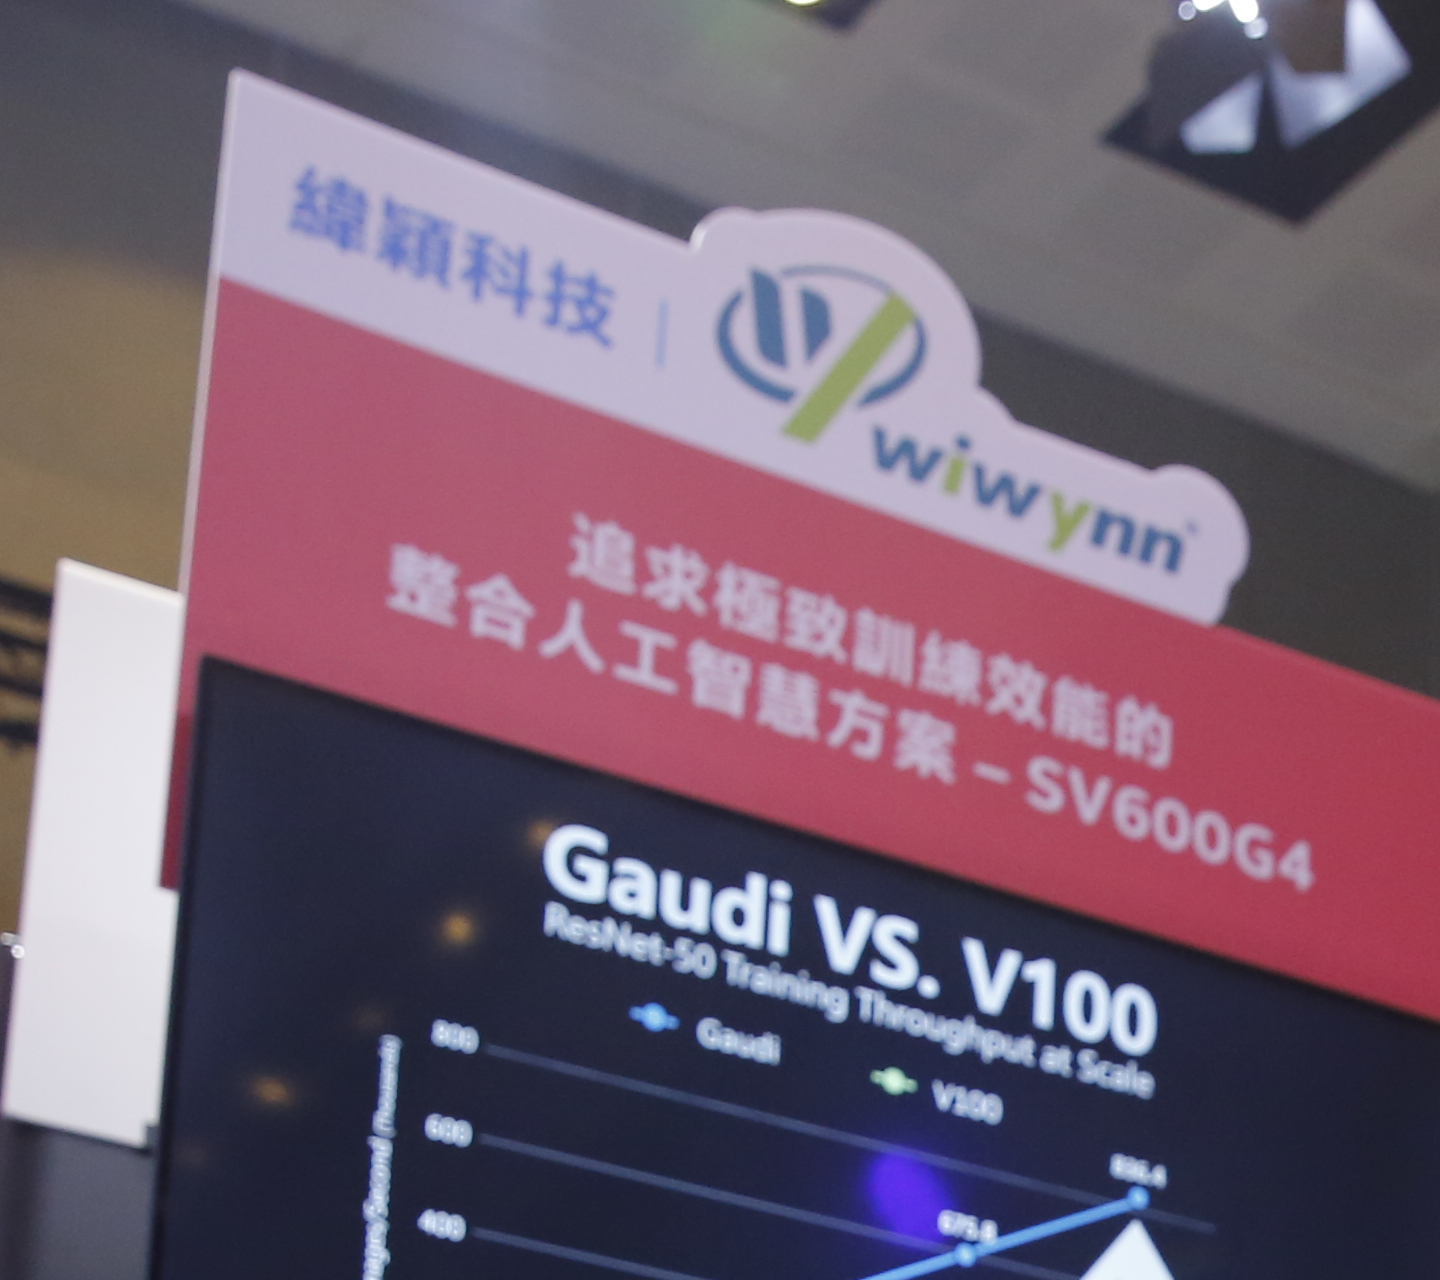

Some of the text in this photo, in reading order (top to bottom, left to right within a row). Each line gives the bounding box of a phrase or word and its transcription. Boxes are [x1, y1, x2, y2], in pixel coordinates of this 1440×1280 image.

[287, 167, 616, 349] 緯穎科技
[871, 423, 1188, 574] wiwynn
[567, 511, 1173, 770] 追求極致訓練效能的
[1025, 755, 1315, 892] SV600G4
[543, 823, 1159, 1057] Gaudi VS. V100
[543, 901, 1156, 1100] ResNet-50 Training Throughput at Scale
[431, 1019, 480, 1055] 800
[695, 1017, 782, 1066] Gaudi
[931, 1079, 1004, 1126] V100
[424, 1113, 473, 1148] 600
[417, 1208, 467, 1242] 400
